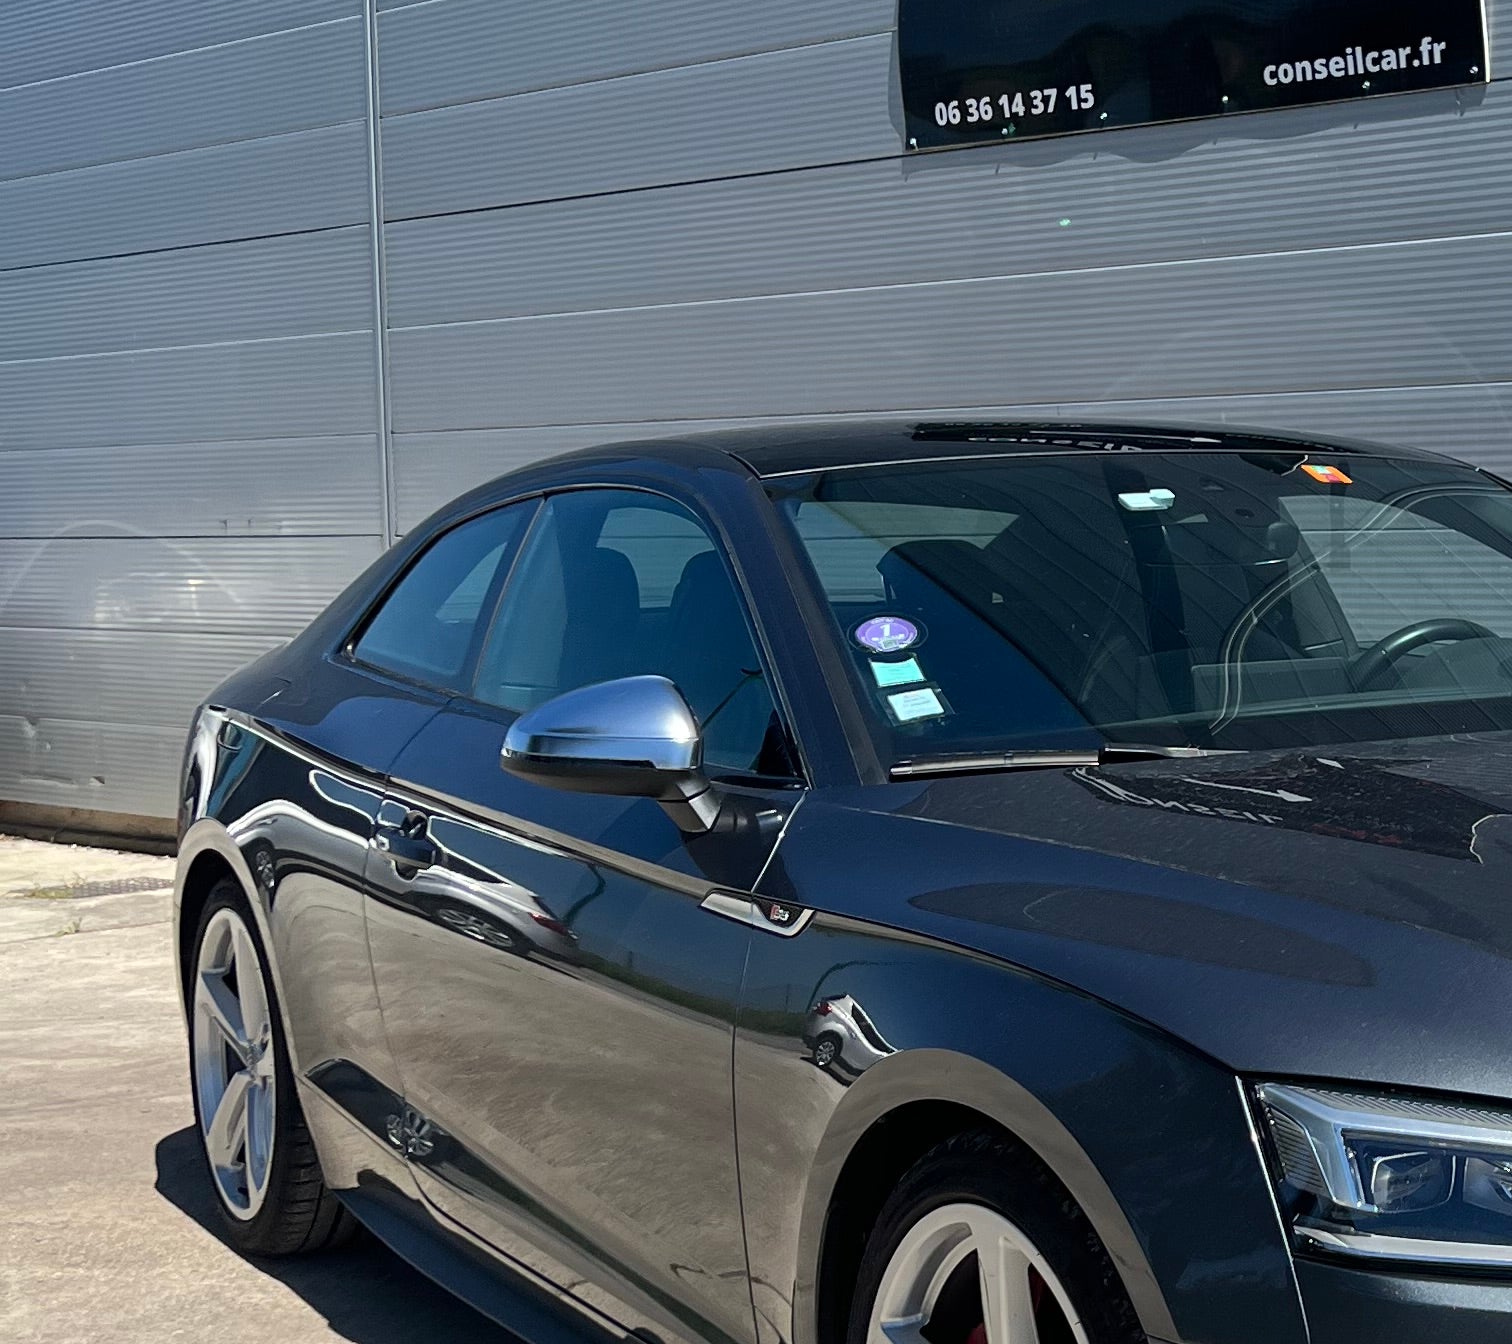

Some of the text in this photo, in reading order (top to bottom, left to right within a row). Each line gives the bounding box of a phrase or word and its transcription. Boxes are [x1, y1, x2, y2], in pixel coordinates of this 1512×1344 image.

[1263, 36, 1446, 86] conseilcar.fr
[935, 84, 1095, 126] 06 36 14 37 15
